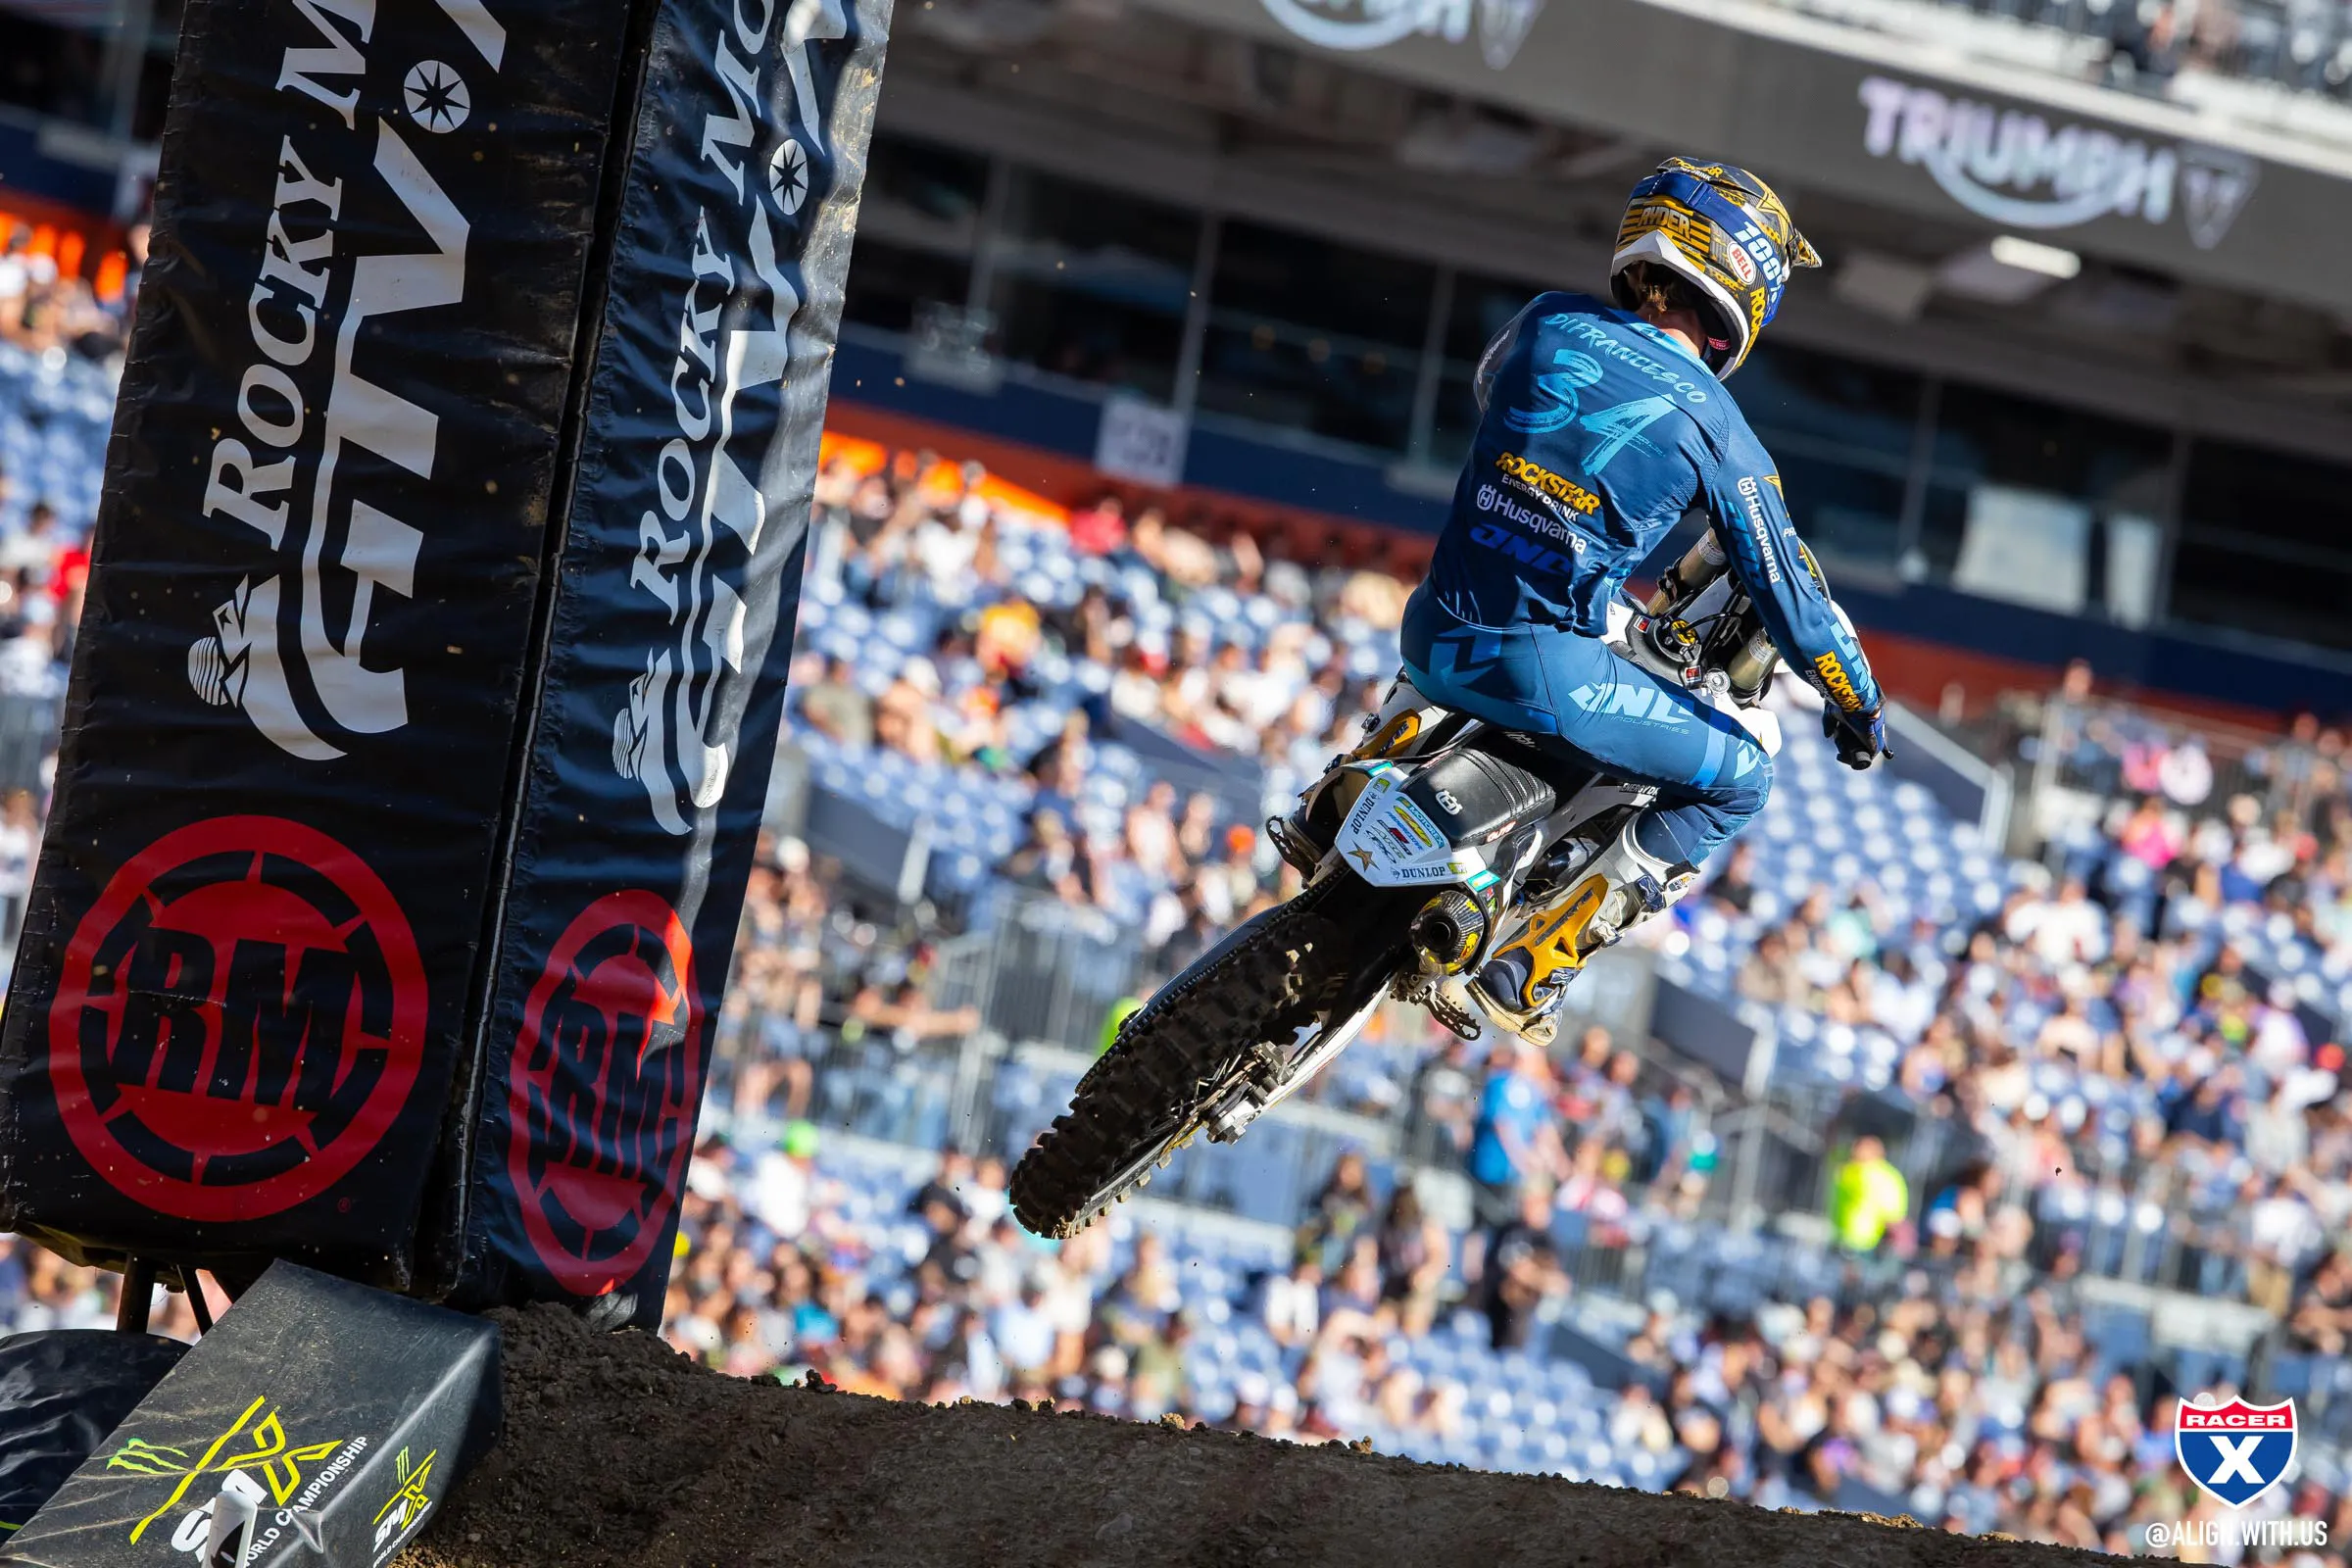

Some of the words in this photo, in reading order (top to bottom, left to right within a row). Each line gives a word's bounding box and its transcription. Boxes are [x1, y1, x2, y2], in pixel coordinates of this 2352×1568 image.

[1858, 74, 2177, 229] TRIUMPH
[1637, 205, 1692, 241] RYDER
[1731, 247, 1752, 281] BELL
[1733, 220, 1785, 304] 100%
[203, 133, 343, 552] ROCKY
[1545, 313, 1708, 404] DIFRANCESCO
[630, 205, 735, 625] ROCKY
[1503, 348, 1679, 476] 34
[1494, 451, 1600, 515] ROCKSTAR
[1501, 473, 1544, 502] ENERGY
[1543, 494, 1581, 522] DRINK
[1493, 493, 1588, 556] Husqvarna
[1744, 493, 1782, 584] Husqvarna
[1610, 714, 1690, 736] INDUSTRIES
[1351, 796, 1376, 836] DUNLOP
[1408, 806, 1445, 846] MOTOREX
[1401, 865, 1446, 879] DUNLOP
